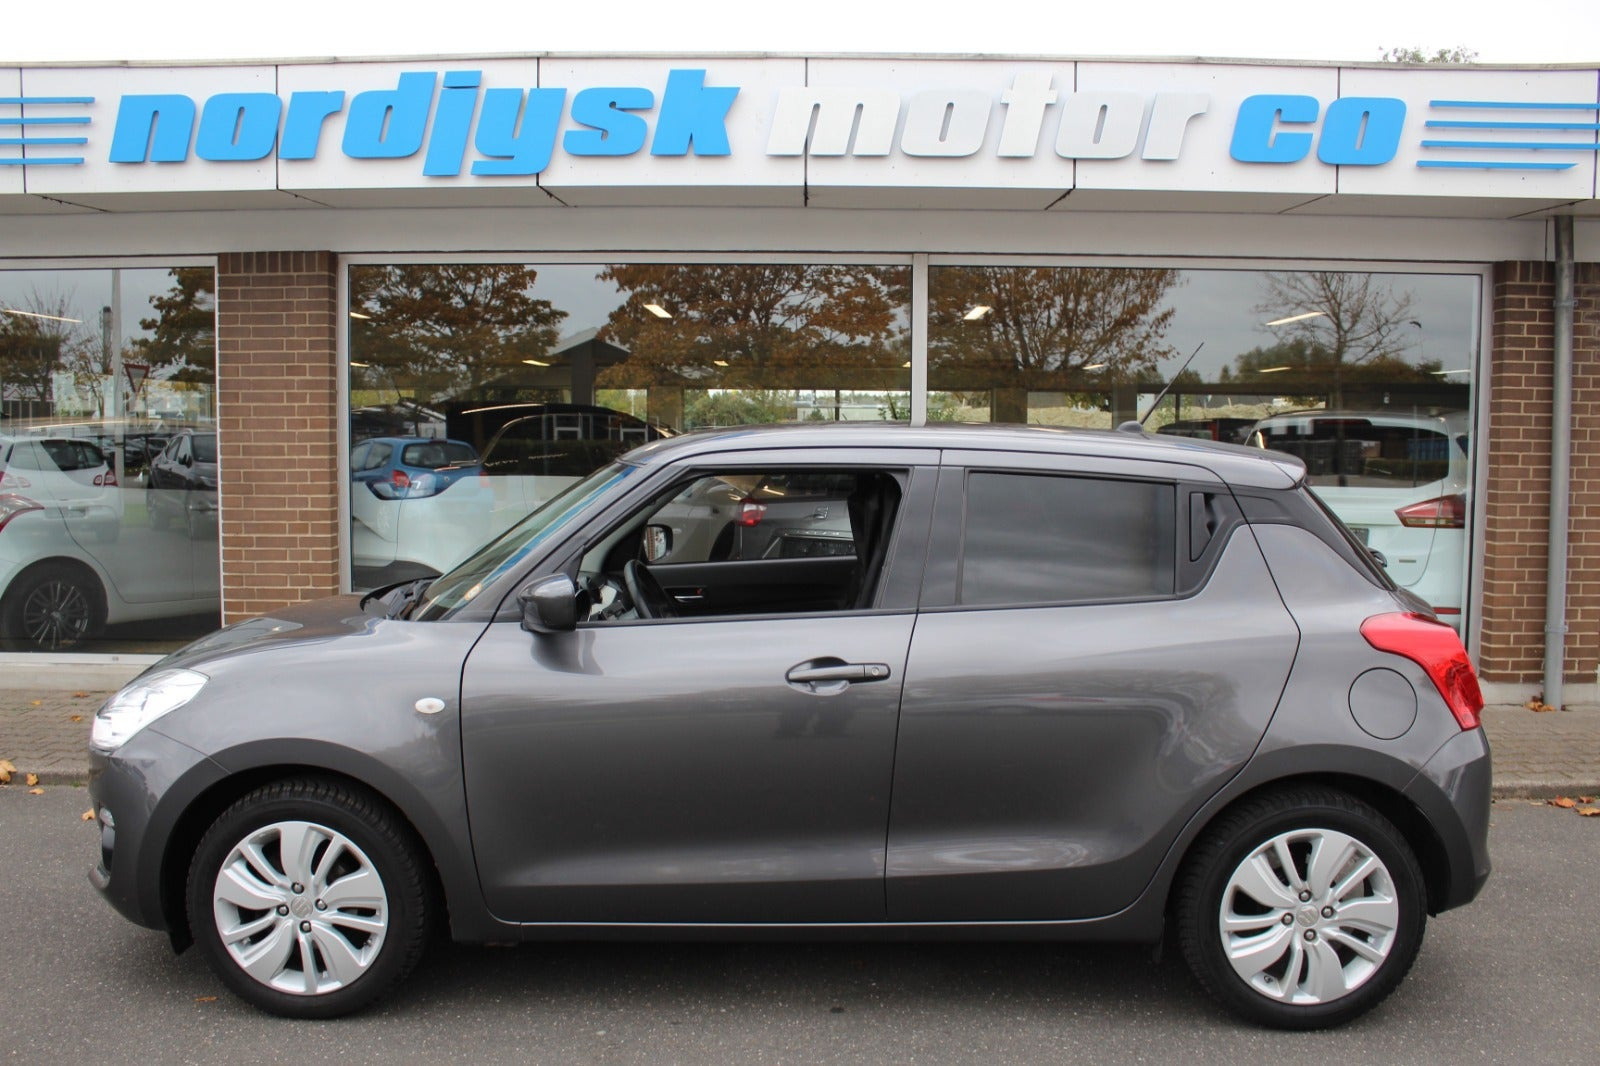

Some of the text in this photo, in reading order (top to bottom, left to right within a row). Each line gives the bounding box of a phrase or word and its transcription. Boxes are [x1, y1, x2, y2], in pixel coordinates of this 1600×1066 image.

[109, 69, 1407, 177] nordjysk motor co
